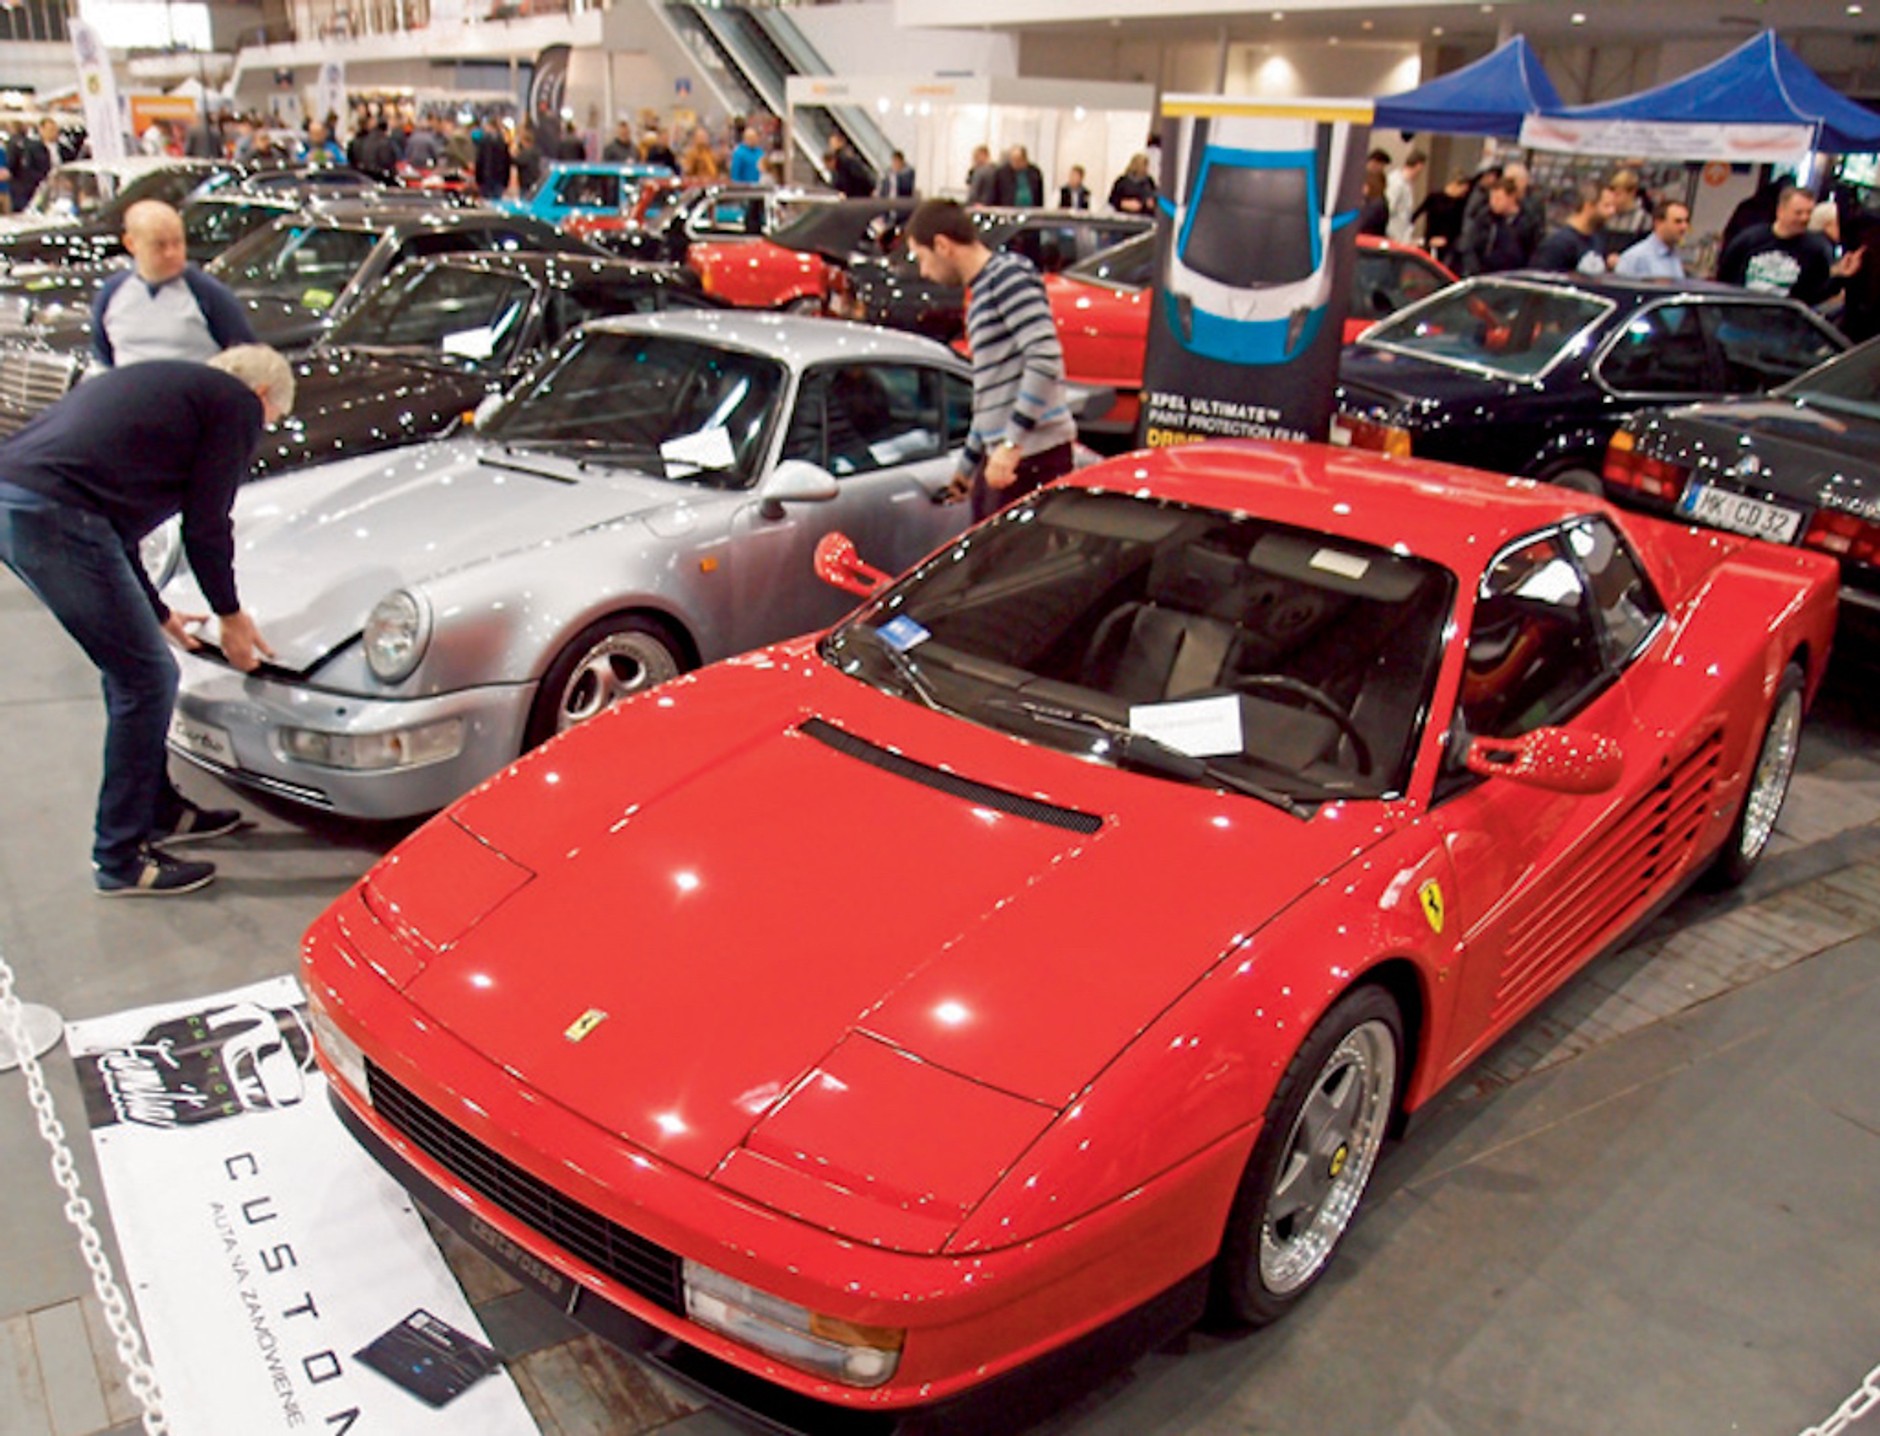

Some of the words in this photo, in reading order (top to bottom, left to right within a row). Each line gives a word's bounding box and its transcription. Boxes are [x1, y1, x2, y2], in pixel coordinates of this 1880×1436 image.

[1150, 392, 1187, 411] XPEL
[1149, 408, 1186, 426] PAINT
[1187, 414, 1272, 441] PROTECTION
